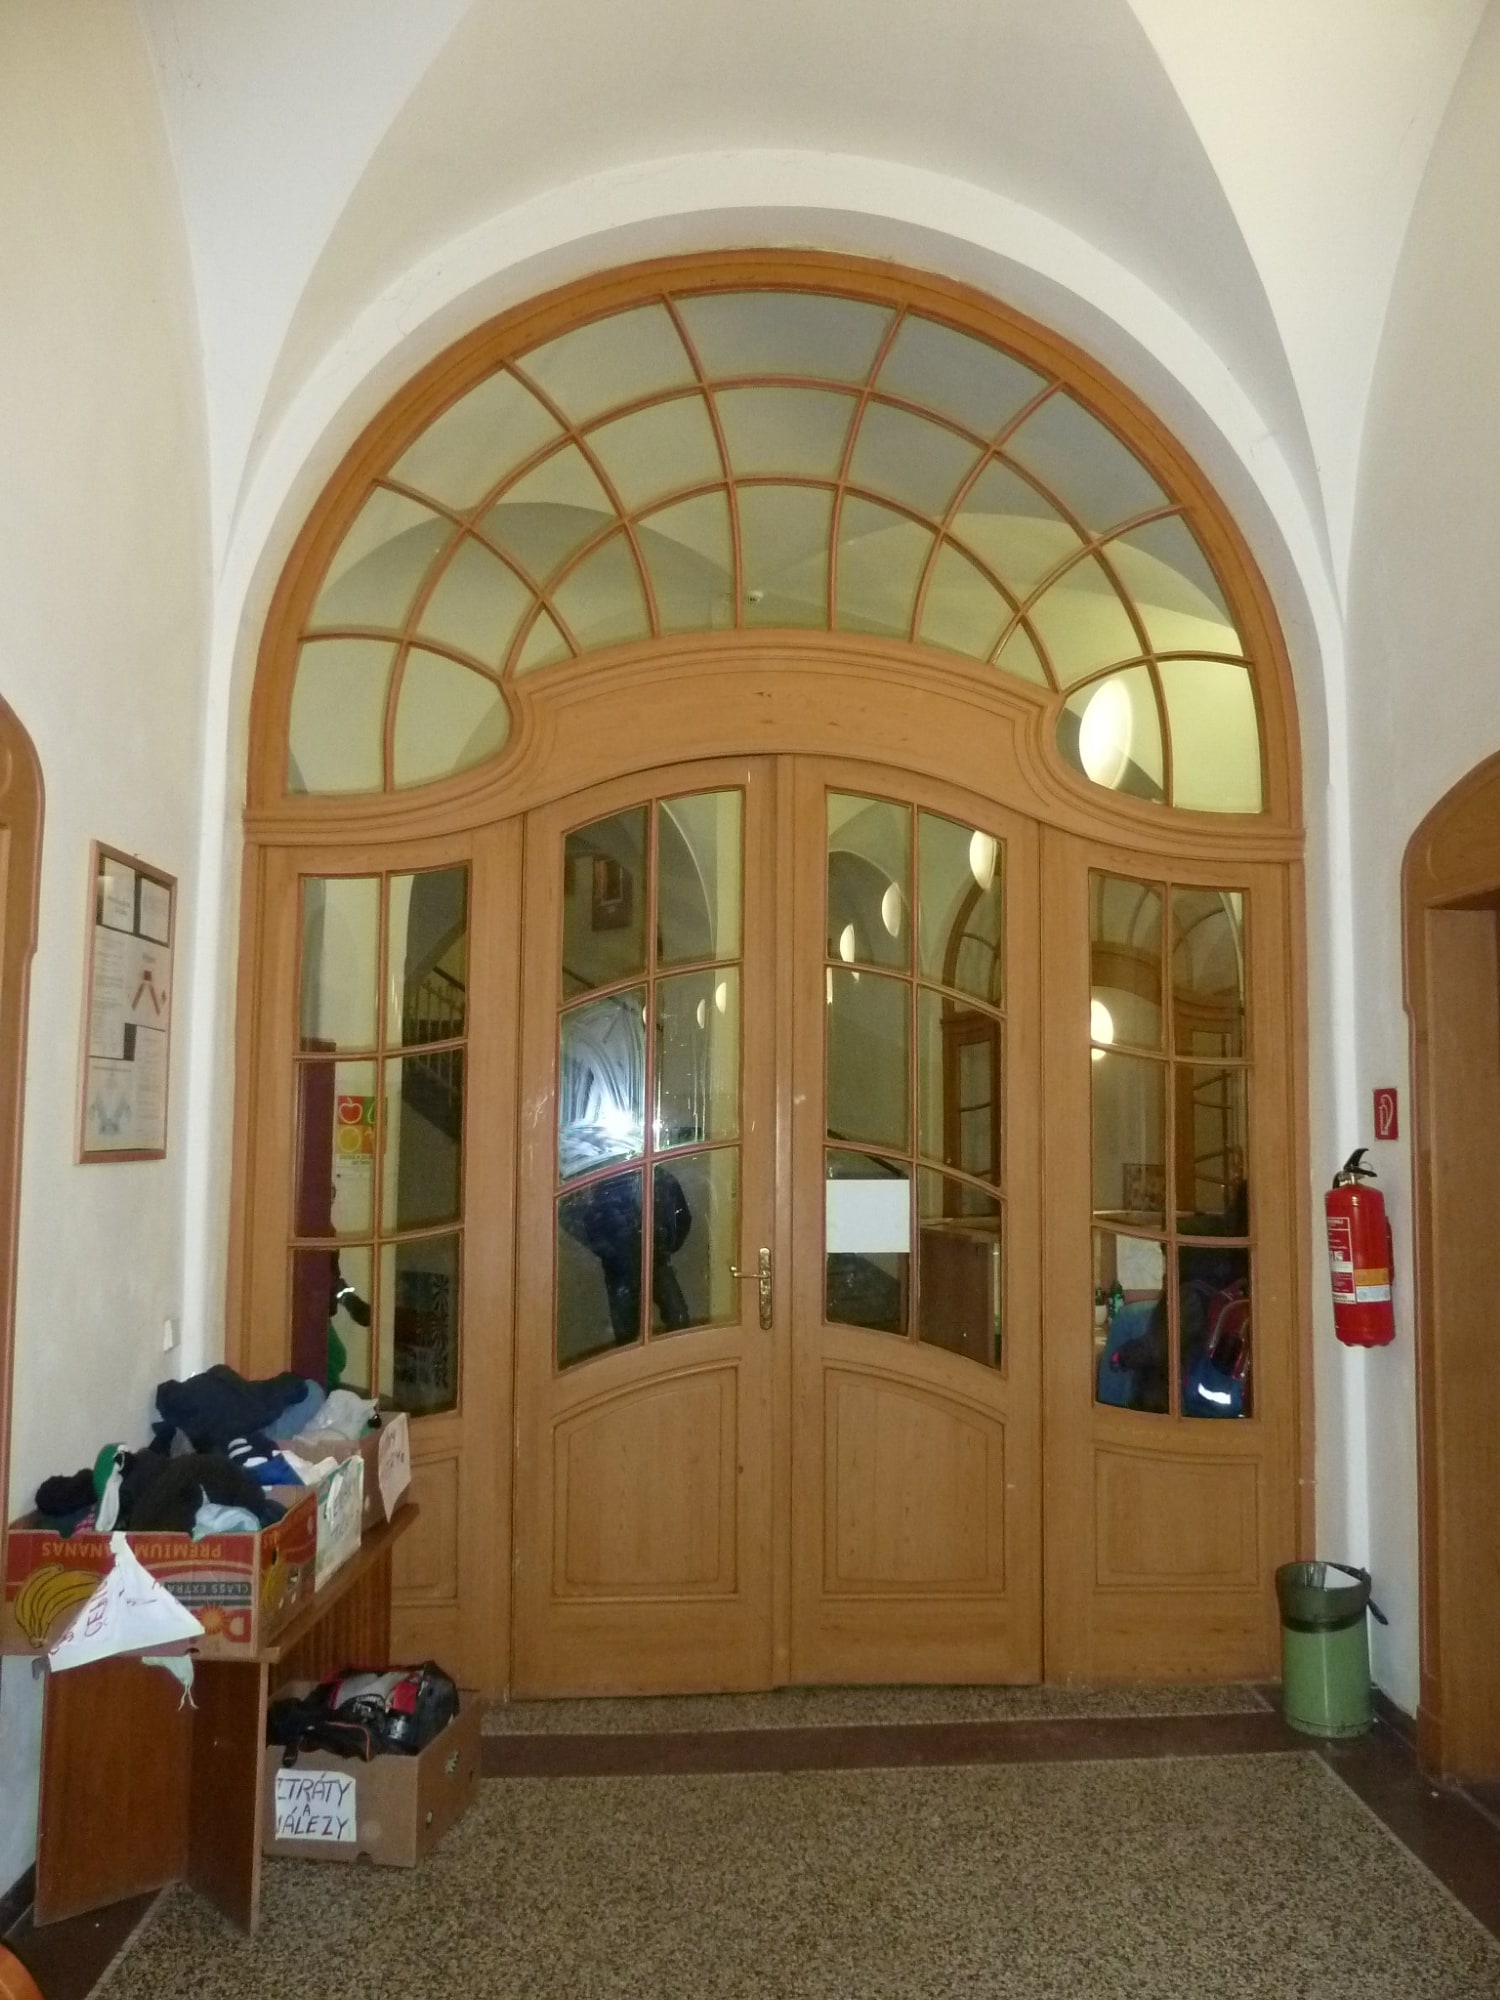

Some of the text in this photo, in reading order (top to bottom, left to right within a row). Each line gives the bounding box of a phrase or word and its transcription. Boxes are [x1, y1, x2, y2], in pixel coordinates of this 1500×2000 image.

[134, 1542, 222, 1559] PREMIUM
[167, 1584, 249, 1594] CLASS EXTRA
[302, 1803, 311, 1817] A
